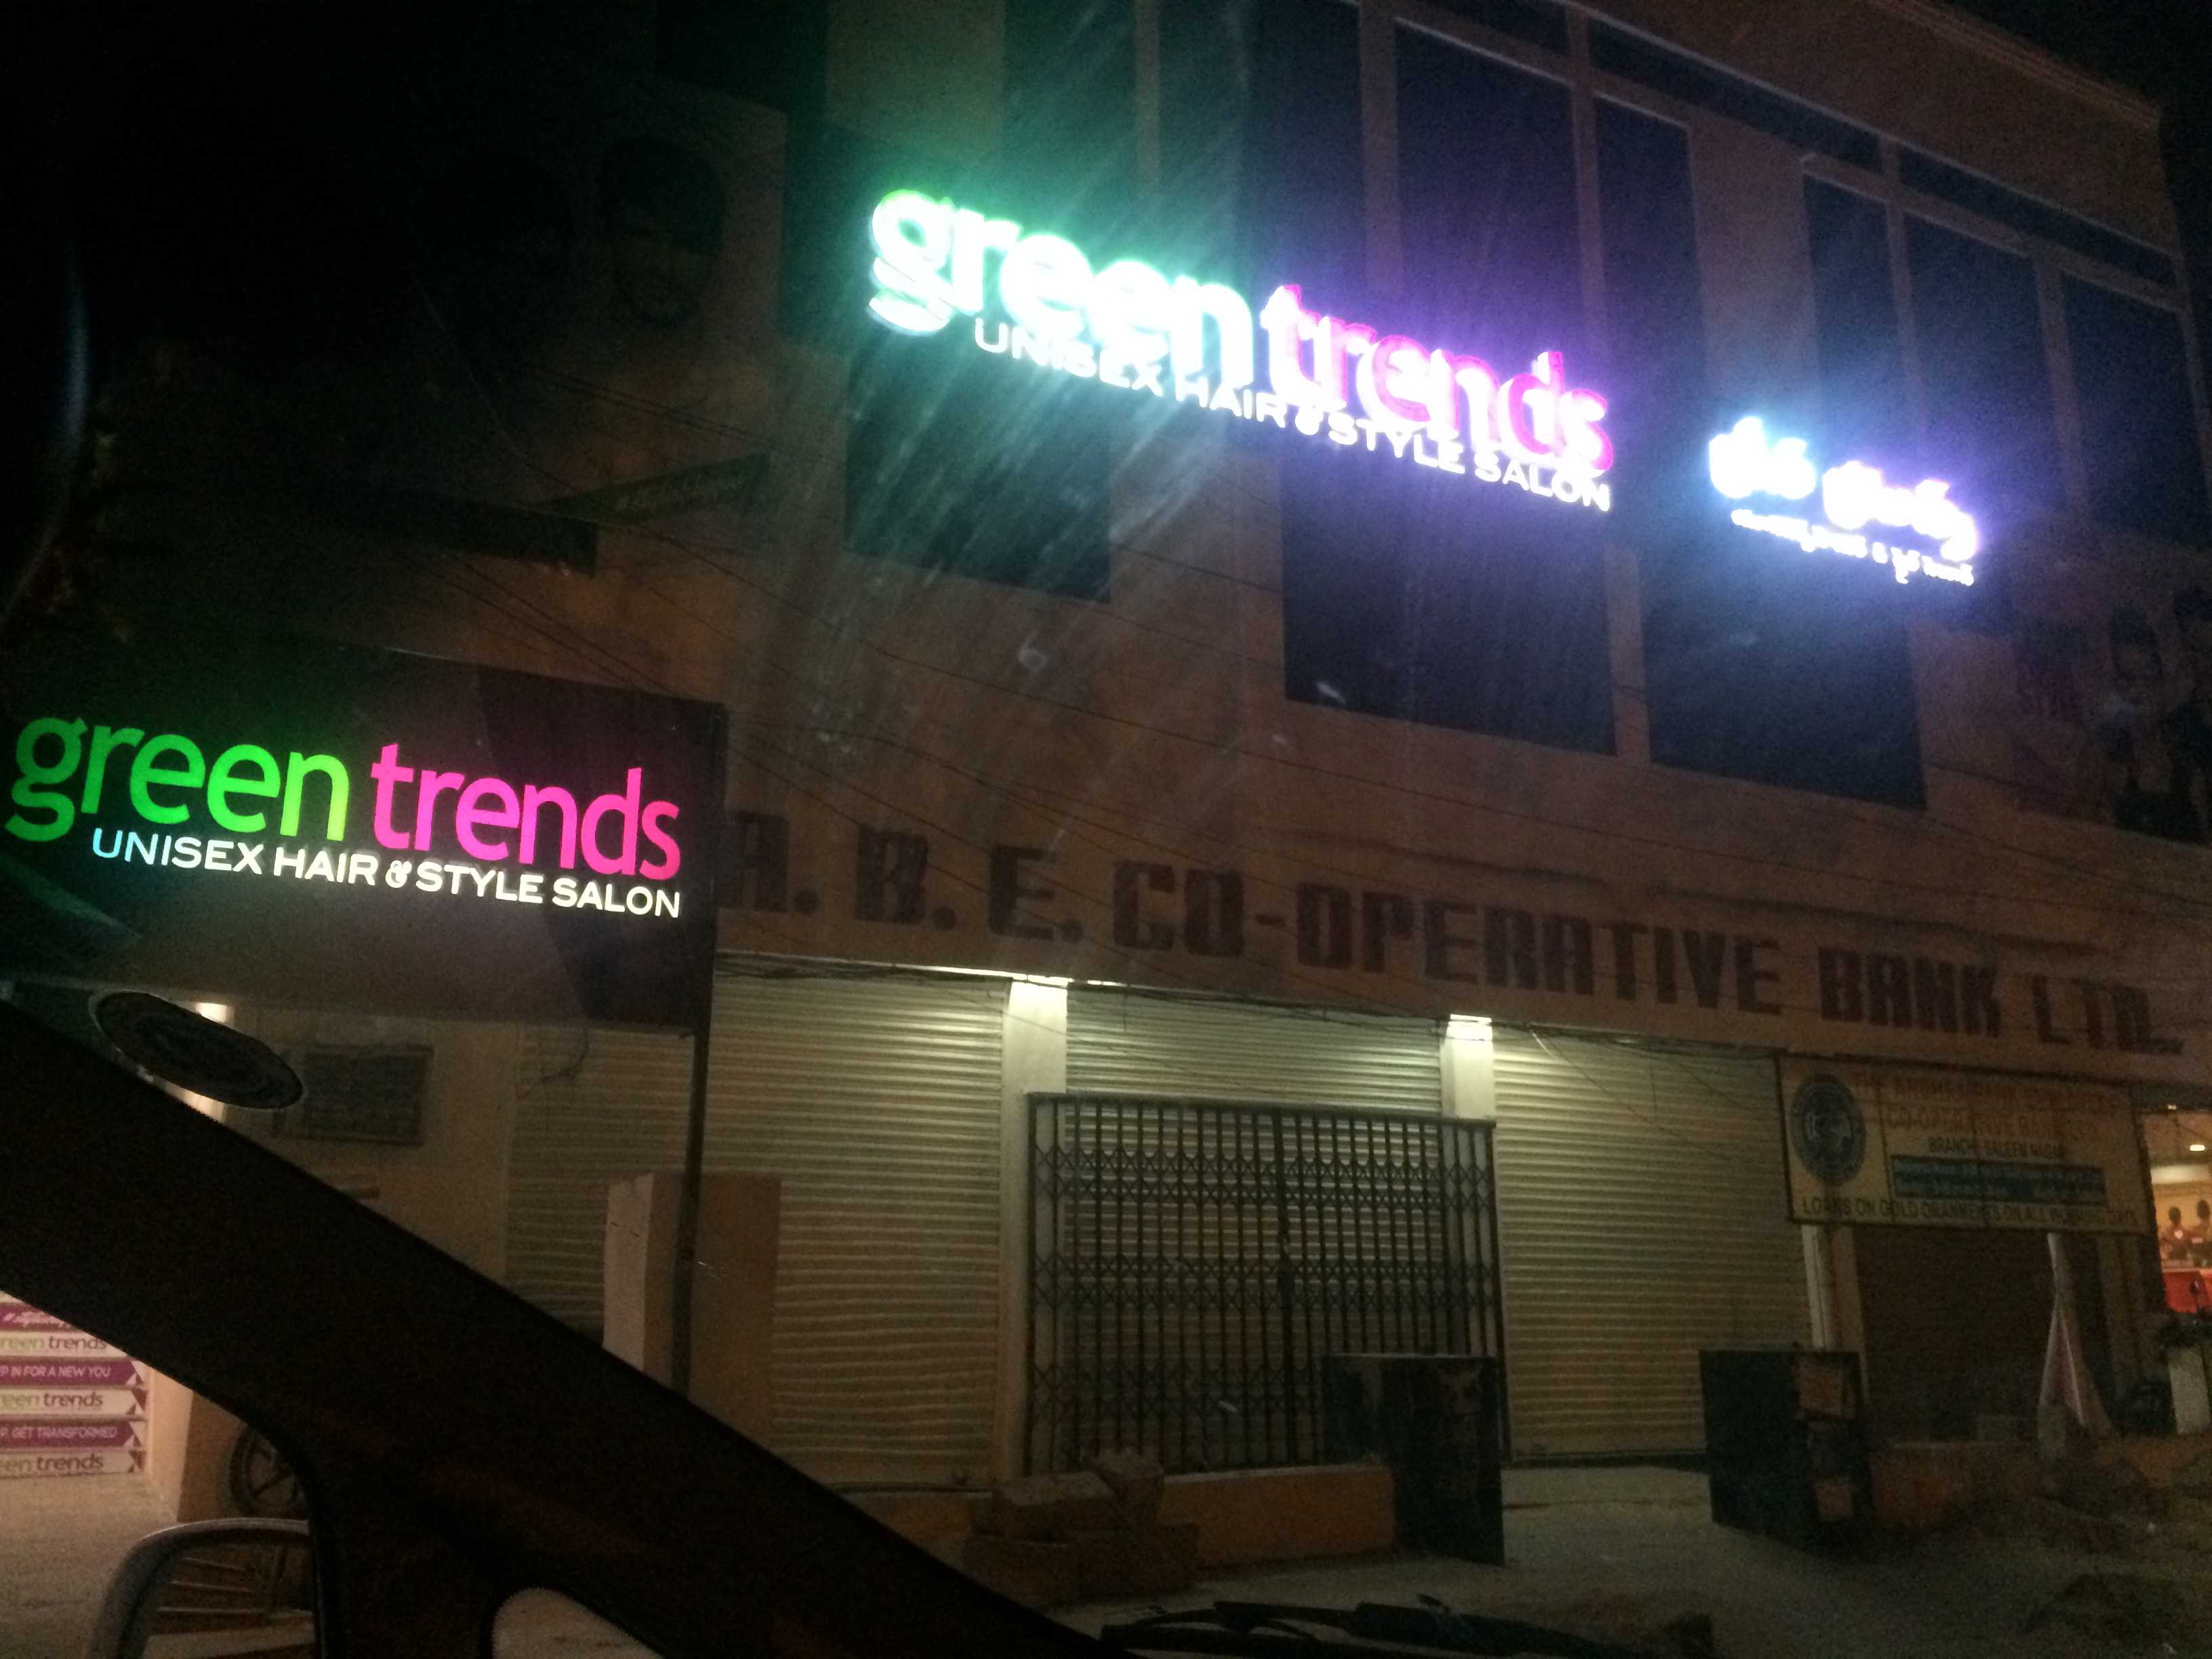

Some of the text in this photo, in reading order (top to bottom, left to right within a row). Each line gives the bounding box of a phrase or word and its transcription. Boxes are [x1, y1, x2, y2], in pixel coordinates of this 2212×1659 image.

[867, 188, 1254, 388] green
[1261, 283, 1614, 478] trends
[973, 317, 1164, 396] UNISEX
[1174, 377, 1288, 429] HAIR
[1326, 405, 1467, 474] STYLE
[1474, 449, 1612, 512] SALON
[4, 716, 680, 881] green trends
[92, 827, 680, 918] UNISEX HAIR & STYLE SALON
[1818, 945, 2000, 1038] BANK
[43, 1391, 103, 1407] trends
[88, 1366, 112, 1378] YOU
[37, 1452, 104, 1472] trends
